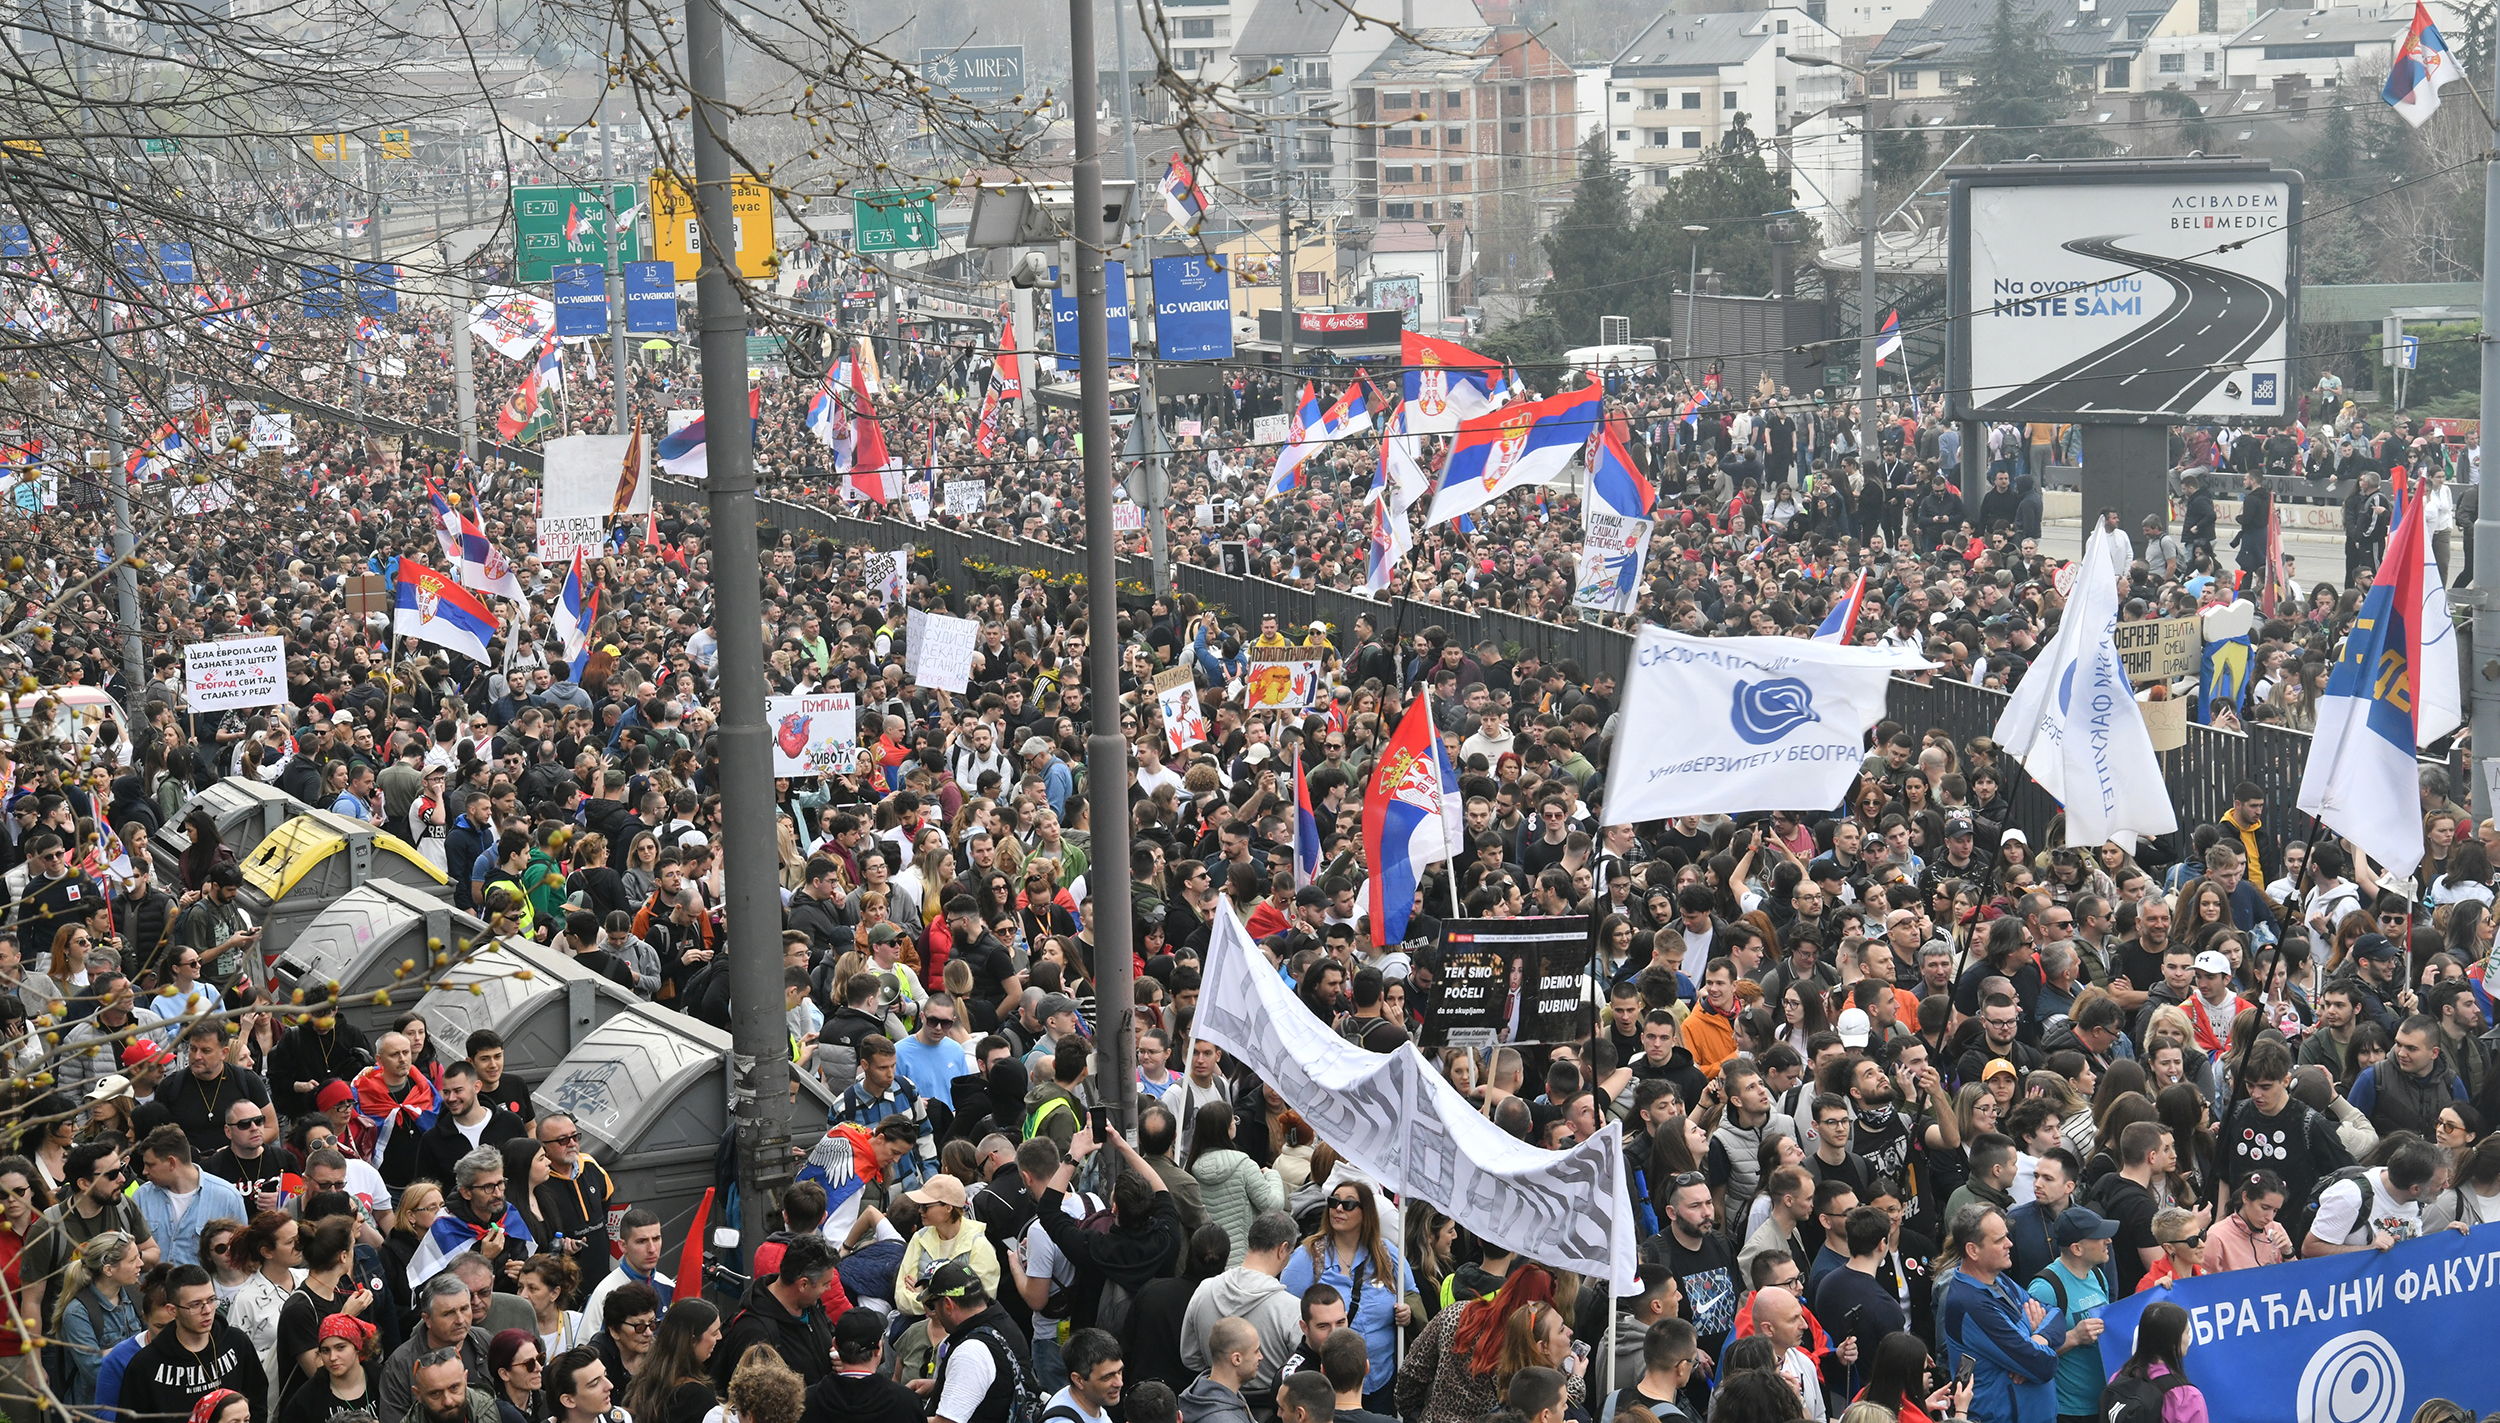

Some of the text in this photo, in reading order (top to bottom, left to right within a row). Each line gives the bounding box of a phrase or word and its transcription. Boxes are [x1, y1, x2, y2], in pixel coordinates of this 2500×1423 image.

[964, 57, 1019, 79] MIREN
[526, 202, 556, 214] E-70
[2171, 195, 2278, 209] ACIBADEM
[584, 205, 604, 221] Šid
[903, 212, 923, 224] Niš
[866, 231, 893, 243] E-75
[567, 240, 595, 253] Novi
[645, 266, 657, 277] 15
[1183, 261, 1200, 278] 15
[1993, 277, 2142, 298] Na ovom putu
[557, 296, 570, 305] LC
[629, 293, 642, 301] LC
[1159, 302, 1177, 315] LC
[1994, 296, 2142, 318] NISTE SAMI
[1057, 311, 1075, 322] LC
[2253, 391, 2274, 399] 1000
[2257, 384, 2274, 392] 309
[542, 517, 596, 533] И ЗА ОВАЈ
[571, 530, 602, 544] ИМАМО
[190, 645, 278, 660] ЦЕЛА ЕВРОПА САДА
[921, 643, 973, 663] ЛЕКАРИ
[2164, 639, 2186, 656] СМЕШ
[191, 655, 277, 670] САЗНАЋЕ ЗА ШТЕТУ
[195, 676, 277, 690] БЕОГРАД СВИ ТАД
[200, 687, 272, 700] СТАЈАЋЕ У РЕДУ
[801, 698, 851, 713] ПУМПАЊА
[809, 751, 851, 766] ЖИВОТА
[1647, 751, 1768, 784] УНИВЕРЗИТЕТ
[1771, 747, 1788, 763] У
[1444, 966, 1493, 979] TEK SMO
[1539, 974, 1583, 990] IDEMO U
[1444, 984, 1485, 999] POČELI
[1454, 1006, 1486, 1016] skupljamo
[1538, 998, 1579, 1014] DUBINU
[98, 1078, 108, 1088] C
[2132, 1273, 2385, 1357] БРАЋАЈНИ
[154, 1362, 207, 1387] ALPHA
